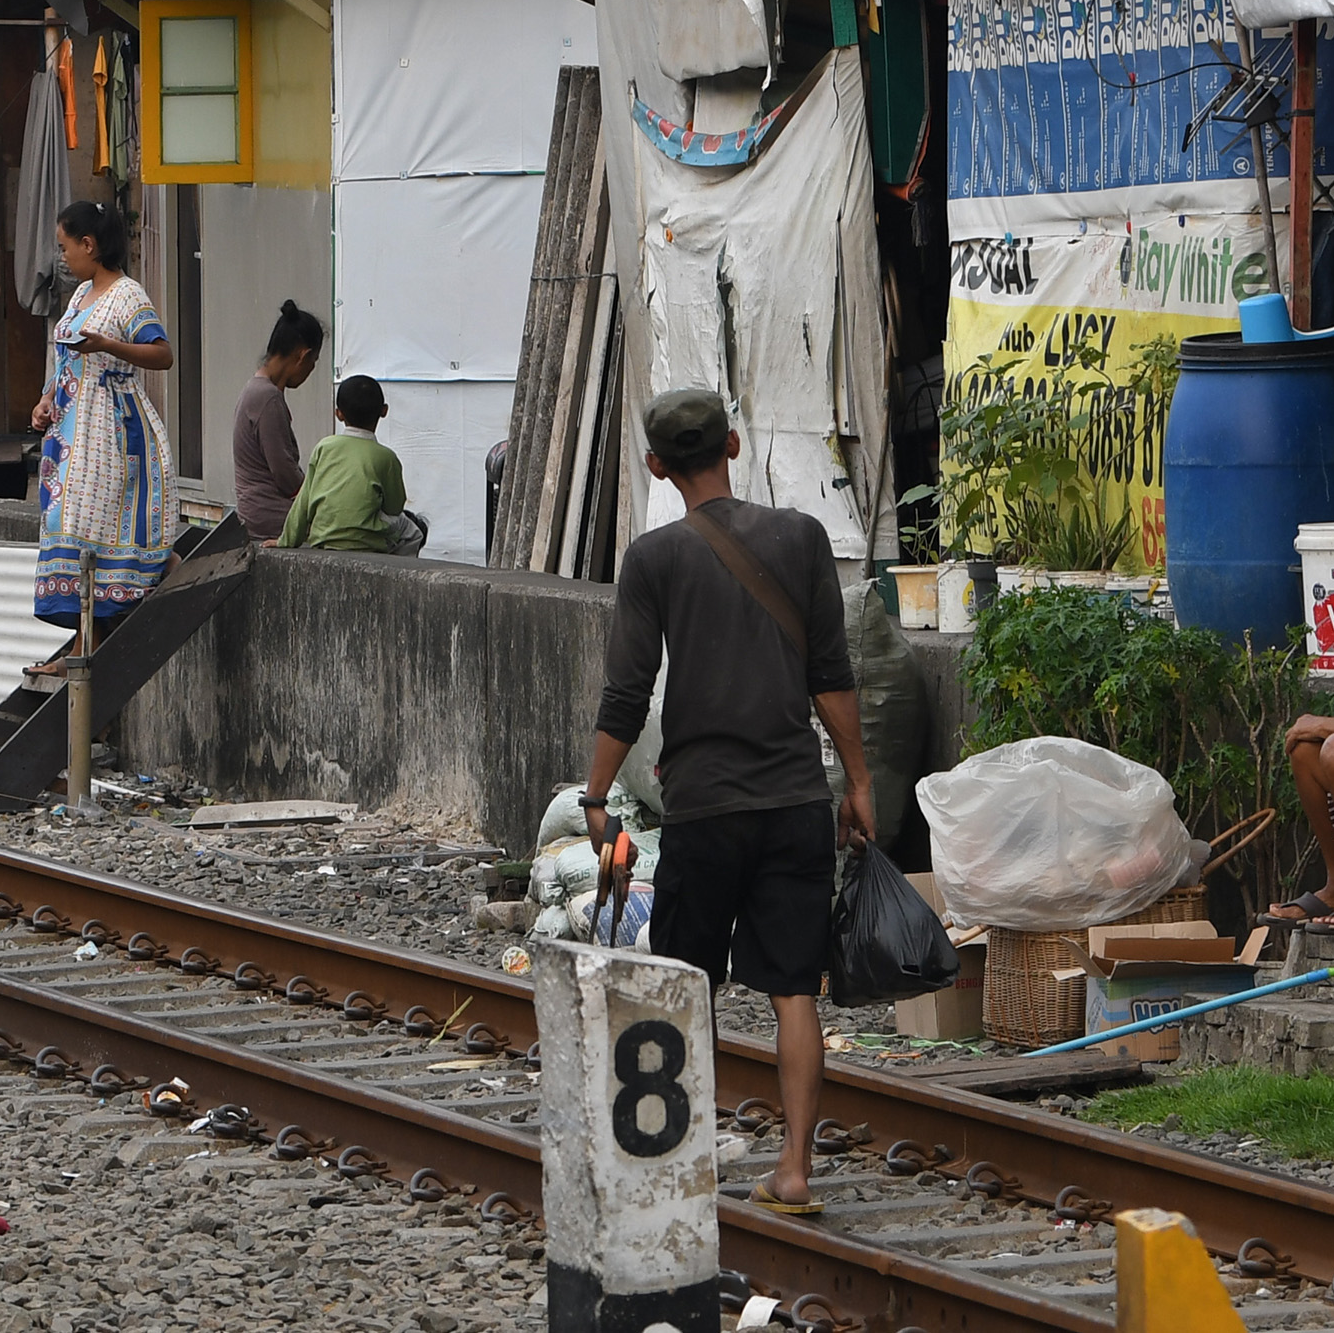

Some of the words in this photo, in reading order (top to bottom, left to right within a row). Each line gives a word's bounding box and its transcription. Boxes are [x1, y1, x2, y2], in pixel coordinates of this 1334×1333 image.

[1135, 228, 1180, 307] Ray
[1180, 235, 1270, 304] White
[1045, 313, 1116, 371] LUCY
[613, 1020, 691, 1158] 8
